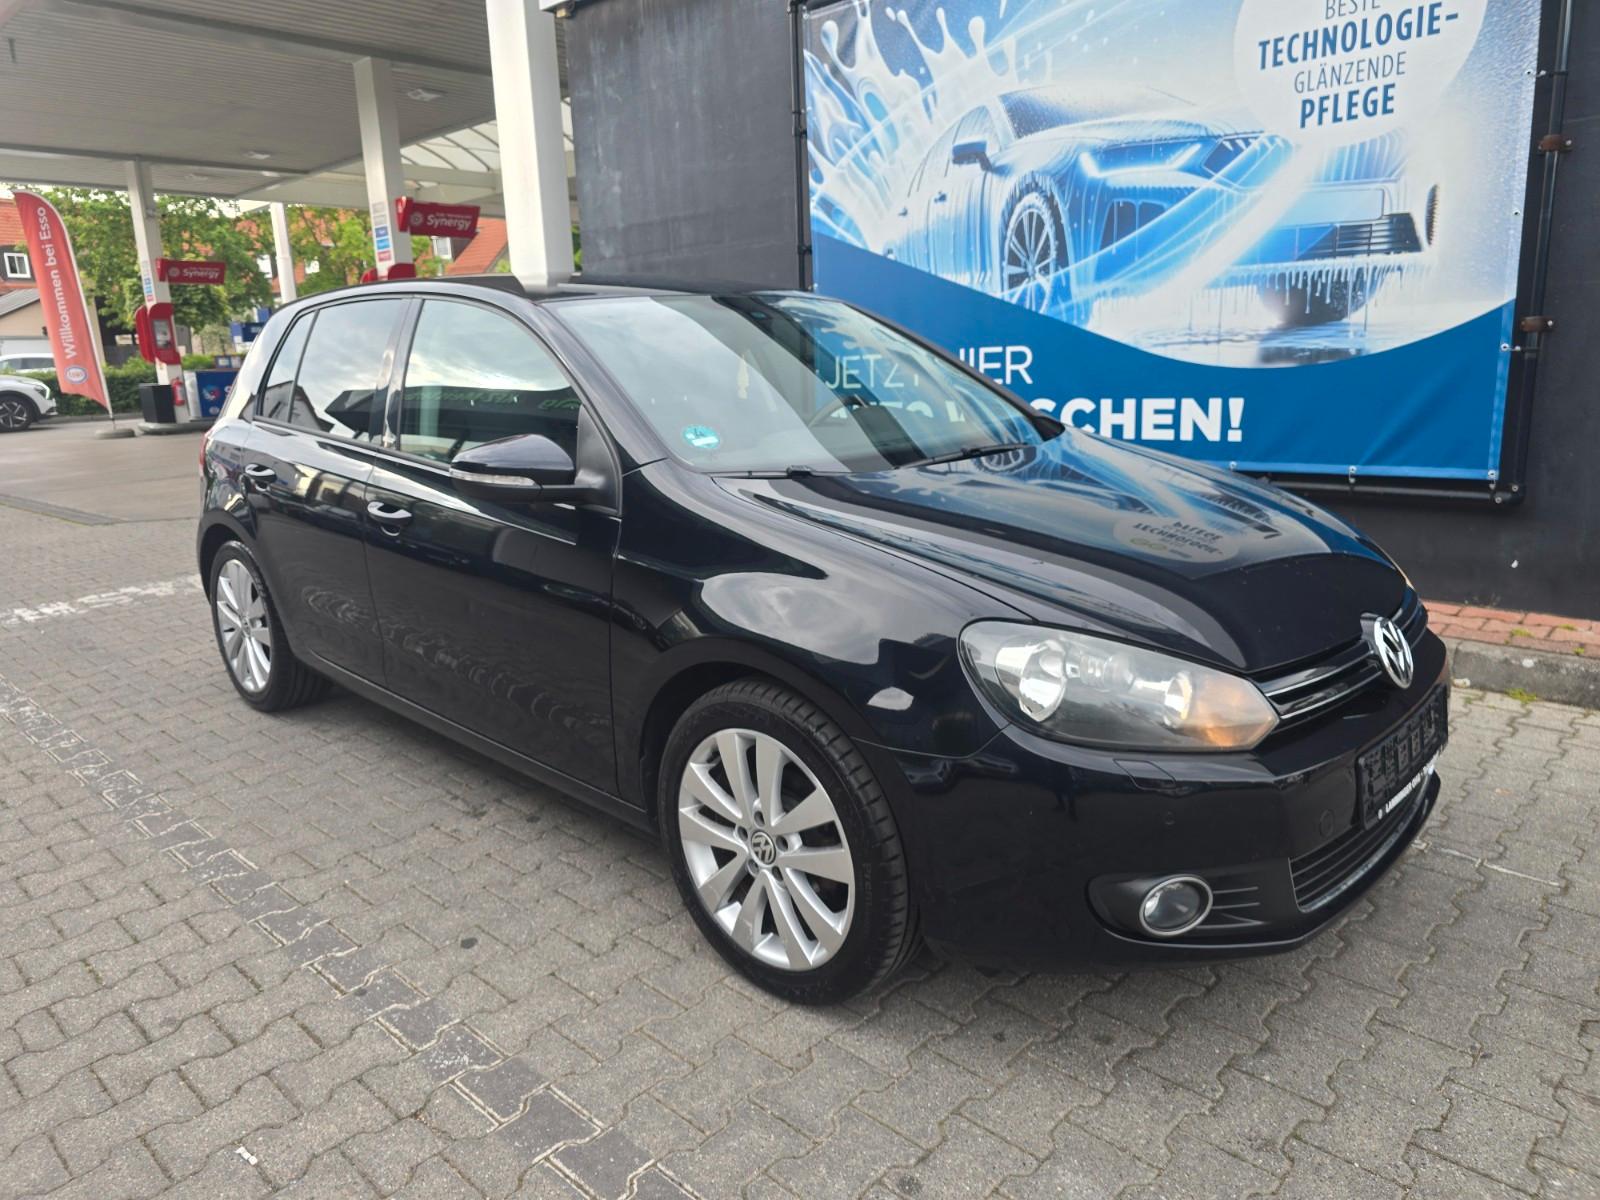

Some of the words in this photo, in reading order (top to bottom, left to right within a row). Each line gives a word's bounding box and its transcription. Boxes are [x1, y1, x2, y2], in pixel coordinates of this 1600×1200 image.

[1258, 2, 1459, 70] TECHNOLOGIE-
[1294, 51, 1407, 93] GLÄNZENDE
[1300, 83, 1396, 129] PFLEGE
[37, 207, 52, 240] Esso
[426, 214, 471, 231] Synergy
[45, 244, 57, 266] bei
[183, 267, 219, 279] Synergy
[50, 270, 77, 359] Willkommen
